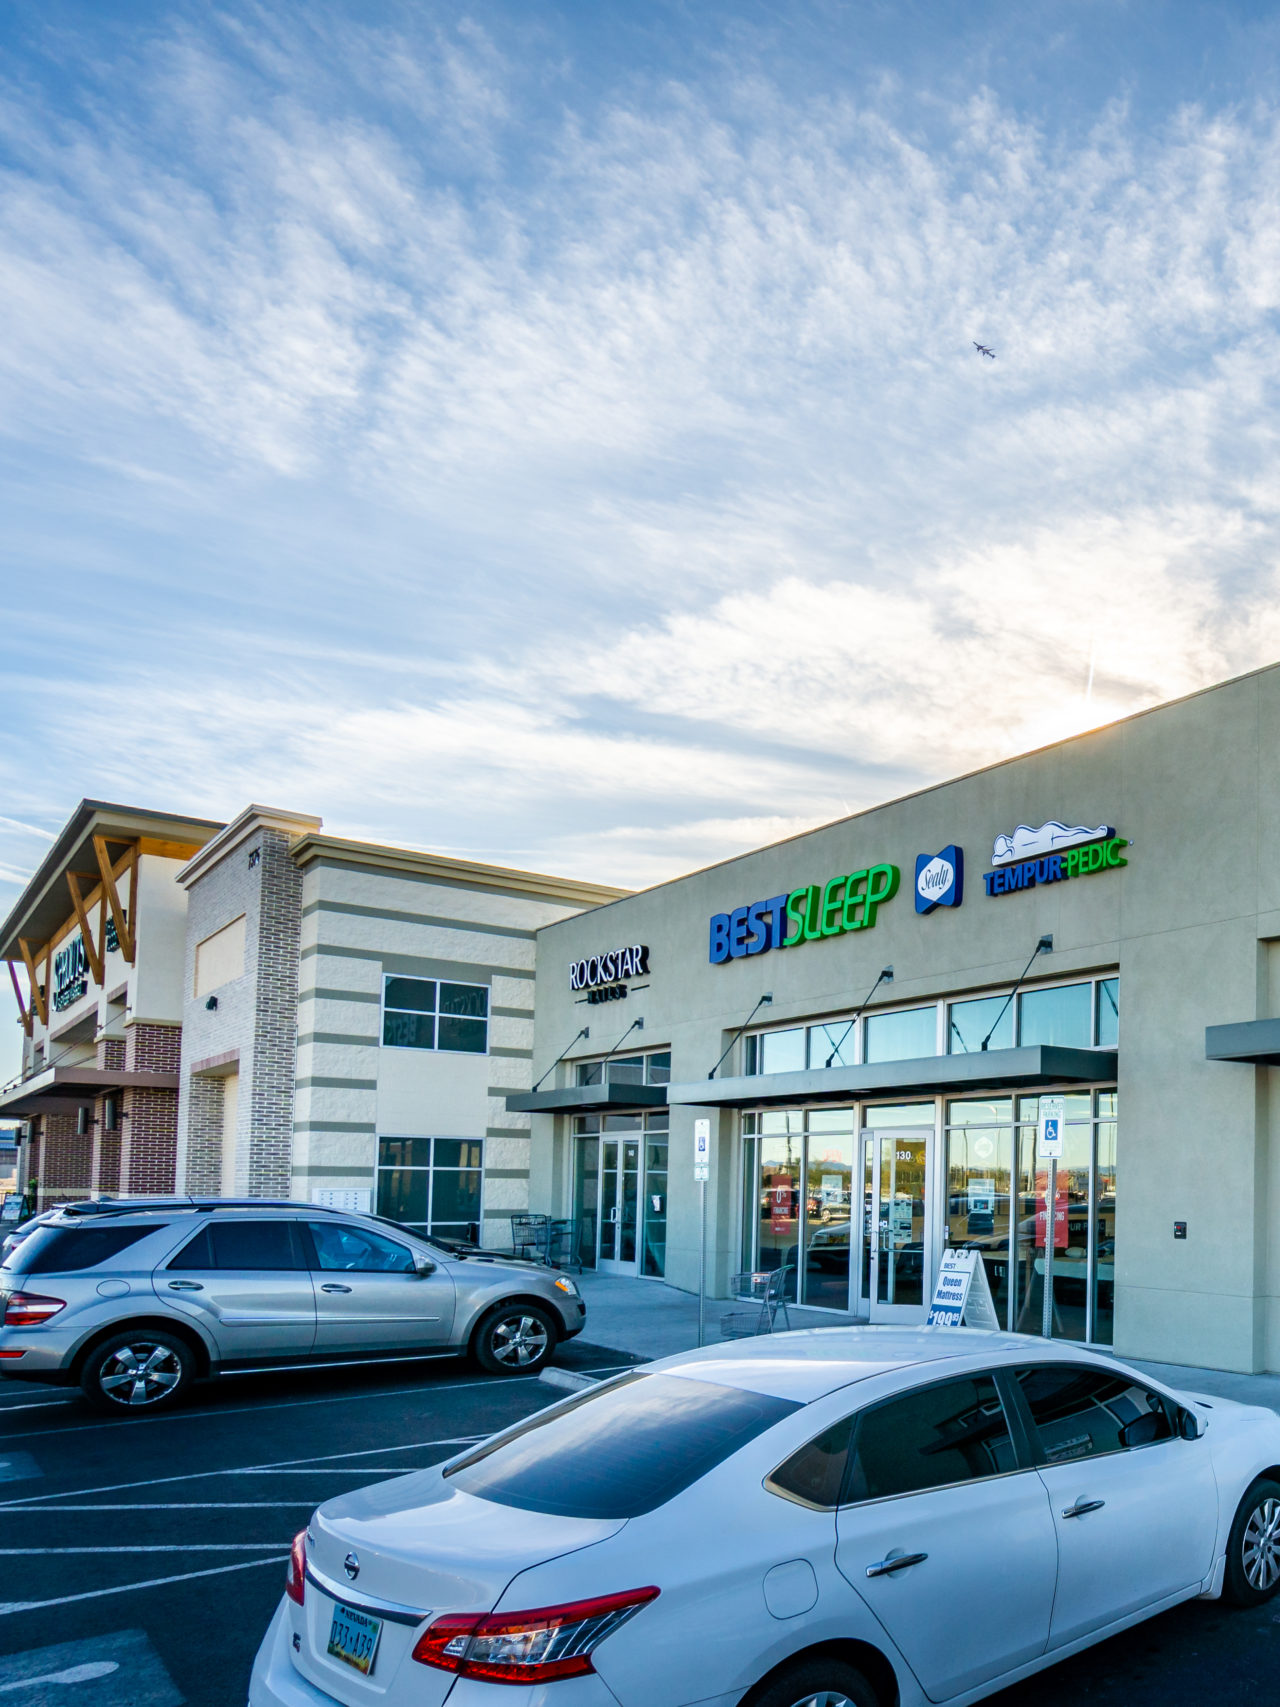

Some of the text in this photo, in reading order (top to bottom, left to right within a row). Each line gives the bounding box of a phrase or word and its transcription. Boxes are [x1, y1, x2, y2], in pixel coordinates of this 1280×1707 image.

[921, 864, 949, 891] Sealy
[983, 838, 1129, 897] TEMPUR-PEDIC
[569, 944, 649, 991] ROCKSTAR
[587, 983, 628, 1005] NAILS
[896, 1151, 911, 1160] 130
[943, 1276, 963, 1287] Queen
[936, 1289, 963, 1301] Mattress
[345, 1609, 368, 1628] NEVADA
